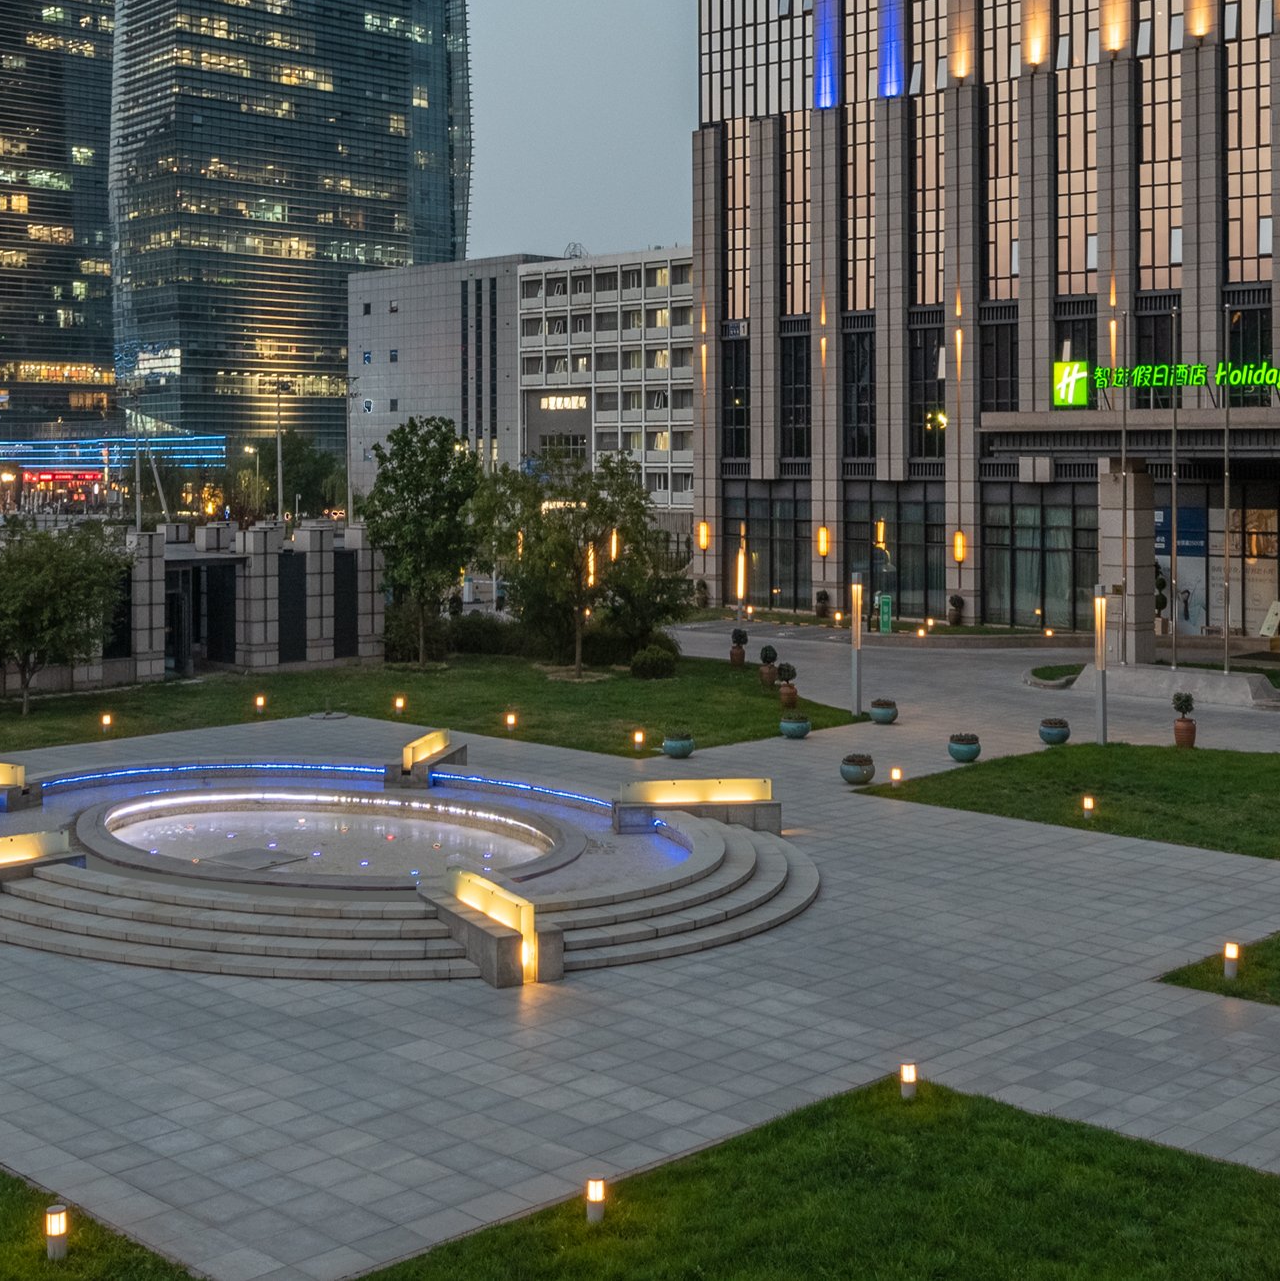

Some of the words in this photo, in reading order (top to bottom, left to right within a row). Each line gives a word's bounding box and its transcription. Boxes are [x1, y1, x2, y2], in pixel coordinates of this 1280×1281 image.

[1094, 364, 1208, 388] 智选假日酒店
